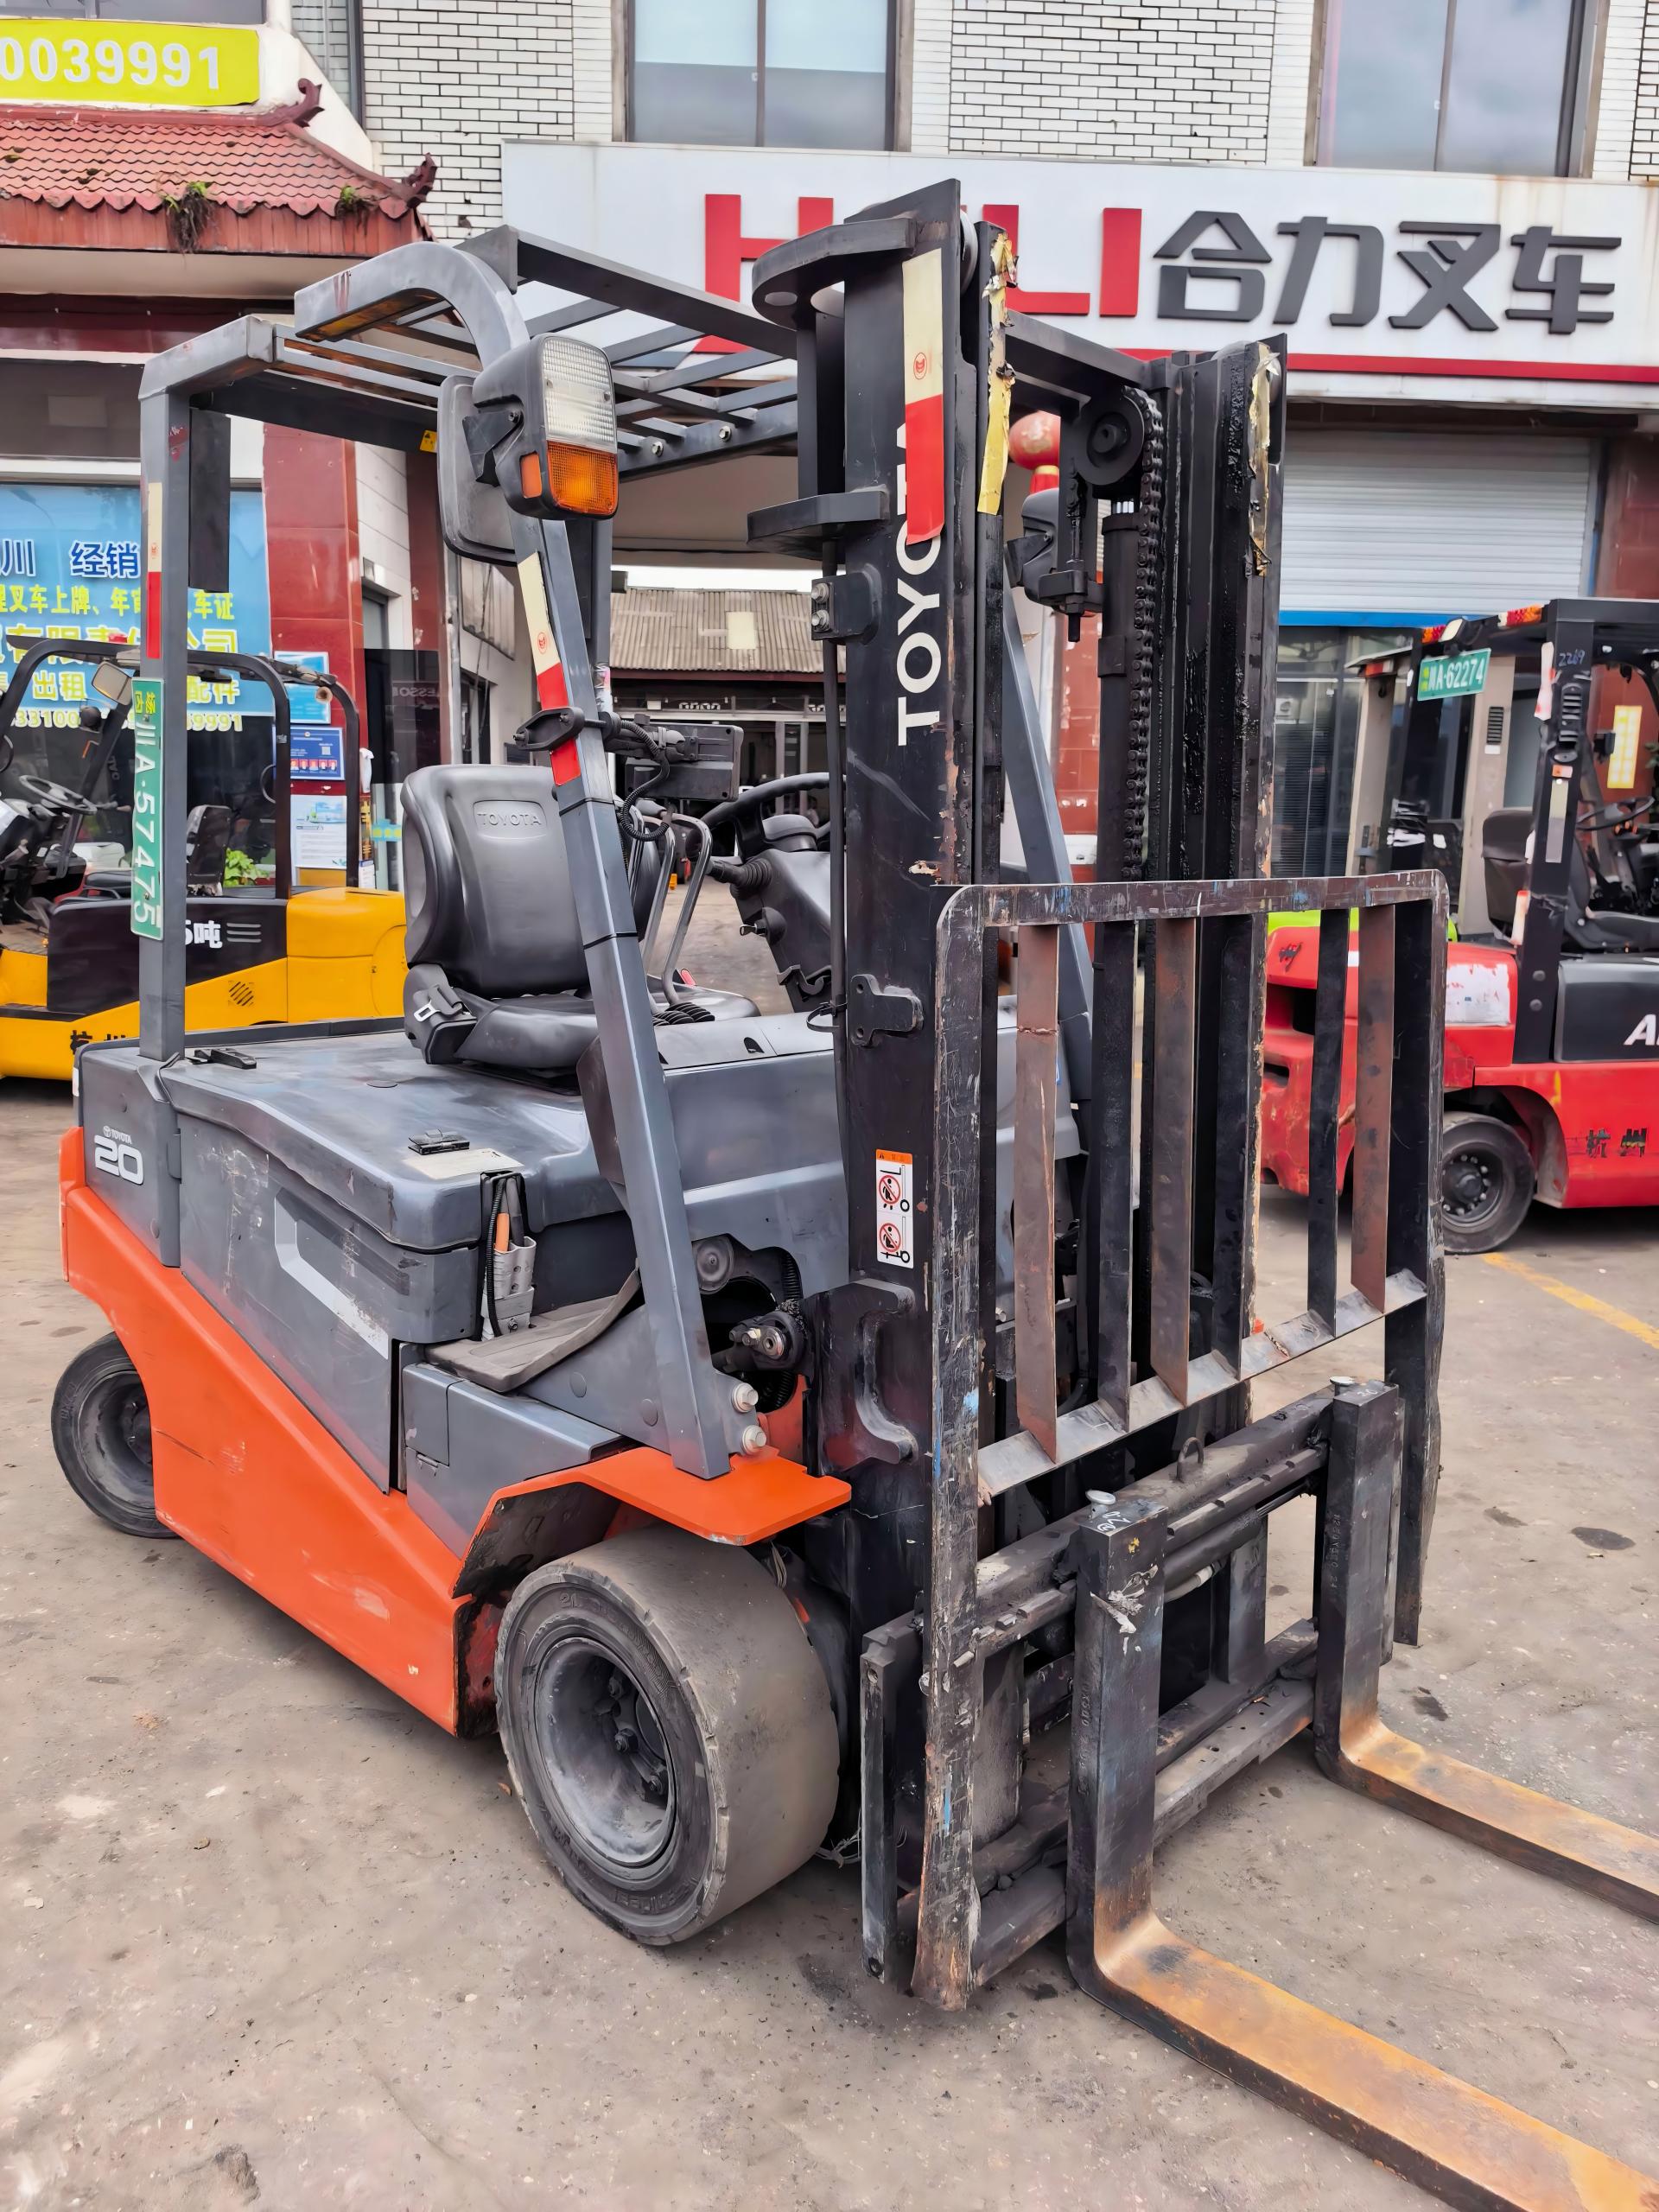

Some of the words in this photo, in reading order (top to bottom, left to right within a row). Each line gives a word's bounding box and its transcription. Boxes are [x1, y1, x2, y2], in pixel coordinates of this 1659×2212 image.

[0, 37, 219, 90] 0039991
[704, 194, 1141, 317] HLI
[1154, 210, 1623, 334] 合力叉车
[31, 670, 88, 702] 出租
[476, 813, 542, 826] TOYOTA
[1624, 1014, 1659, 1046] A
[111, 1128, 132, 1145] TOYOTA
[94, 1135, 144, 1185] 20
